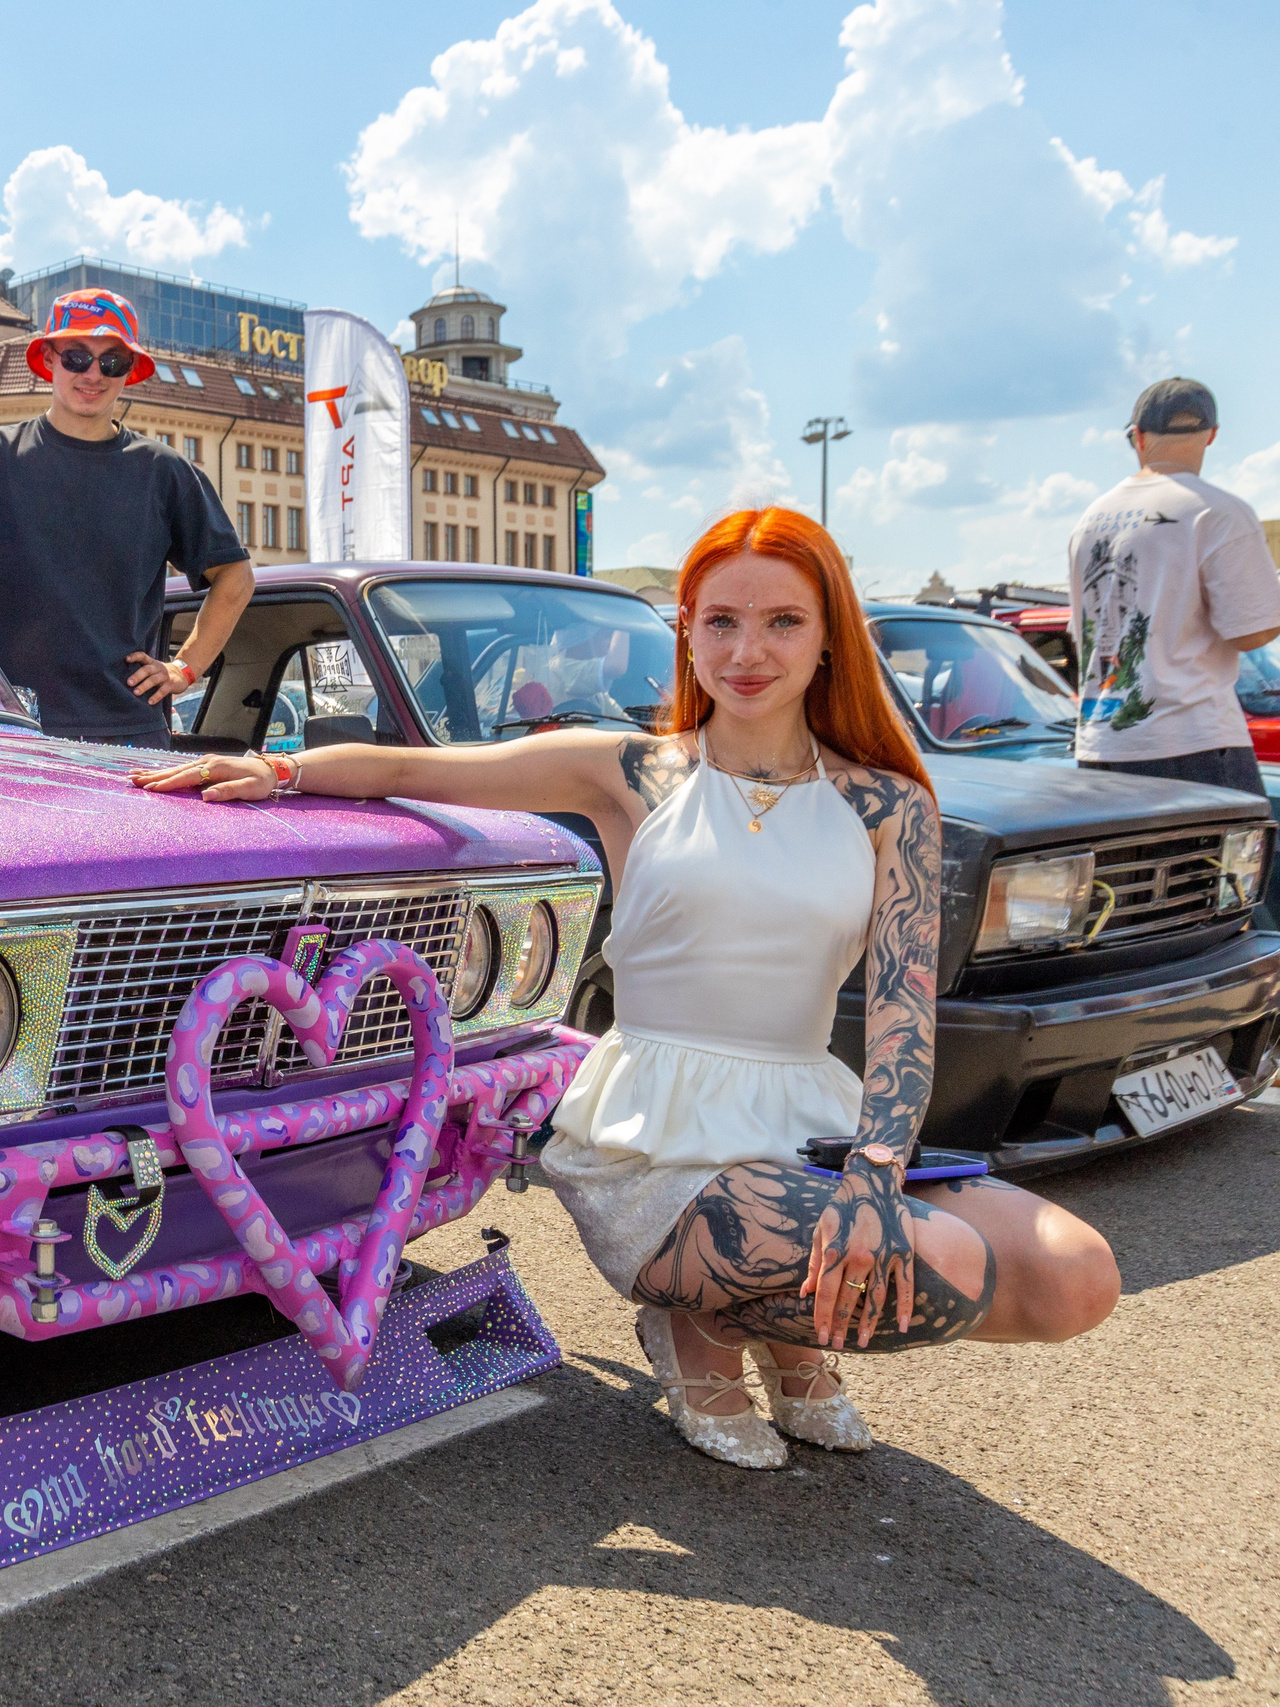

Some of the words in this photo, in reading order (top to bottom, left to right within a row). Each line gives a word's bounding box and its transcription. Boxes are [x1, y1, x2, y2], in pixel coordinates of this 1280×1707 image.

[64, 301, 103, 313] EXHAUST
[238, 311, 305, 361] Гост
[396, 346, 448, 397] вор
[41, 1463, 87, 1522] no
[94, 1412, 178, 1490] hard
[185, 1391, 325, 1447] feelings
